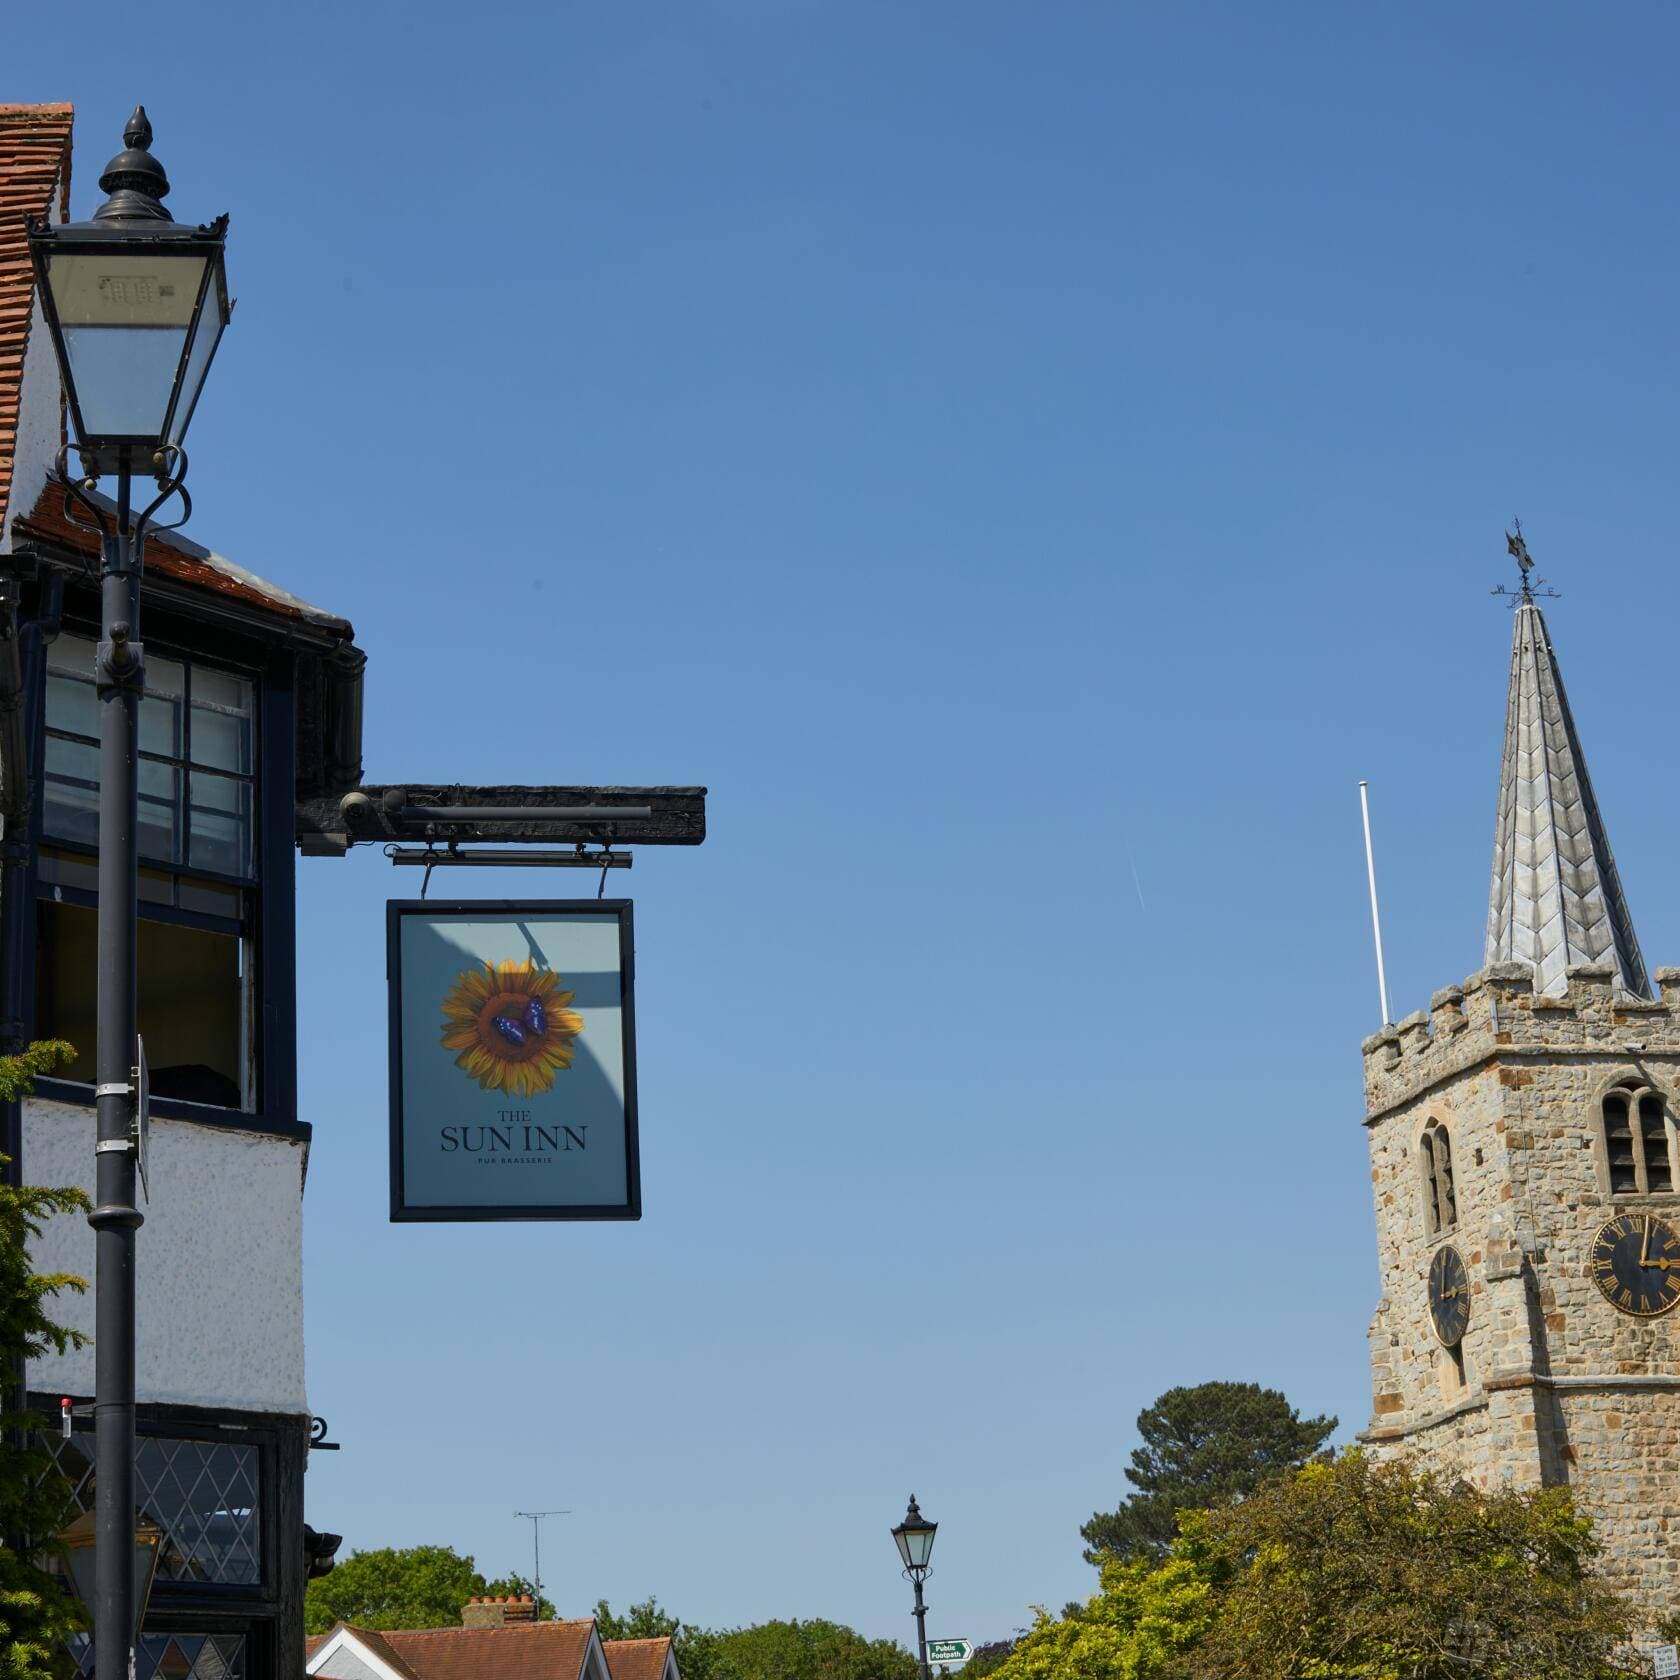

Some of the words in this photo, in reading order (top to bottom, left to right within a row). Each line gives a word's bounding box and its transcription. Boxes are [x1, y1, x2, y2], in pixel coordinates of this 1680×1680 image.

[497, 1110, 532, 1122] THE
[440, 1126, 514, 1152] SUN
[524, 1126, 589, 1151] INN
[931, 1651, 961, 1659] Footpath
